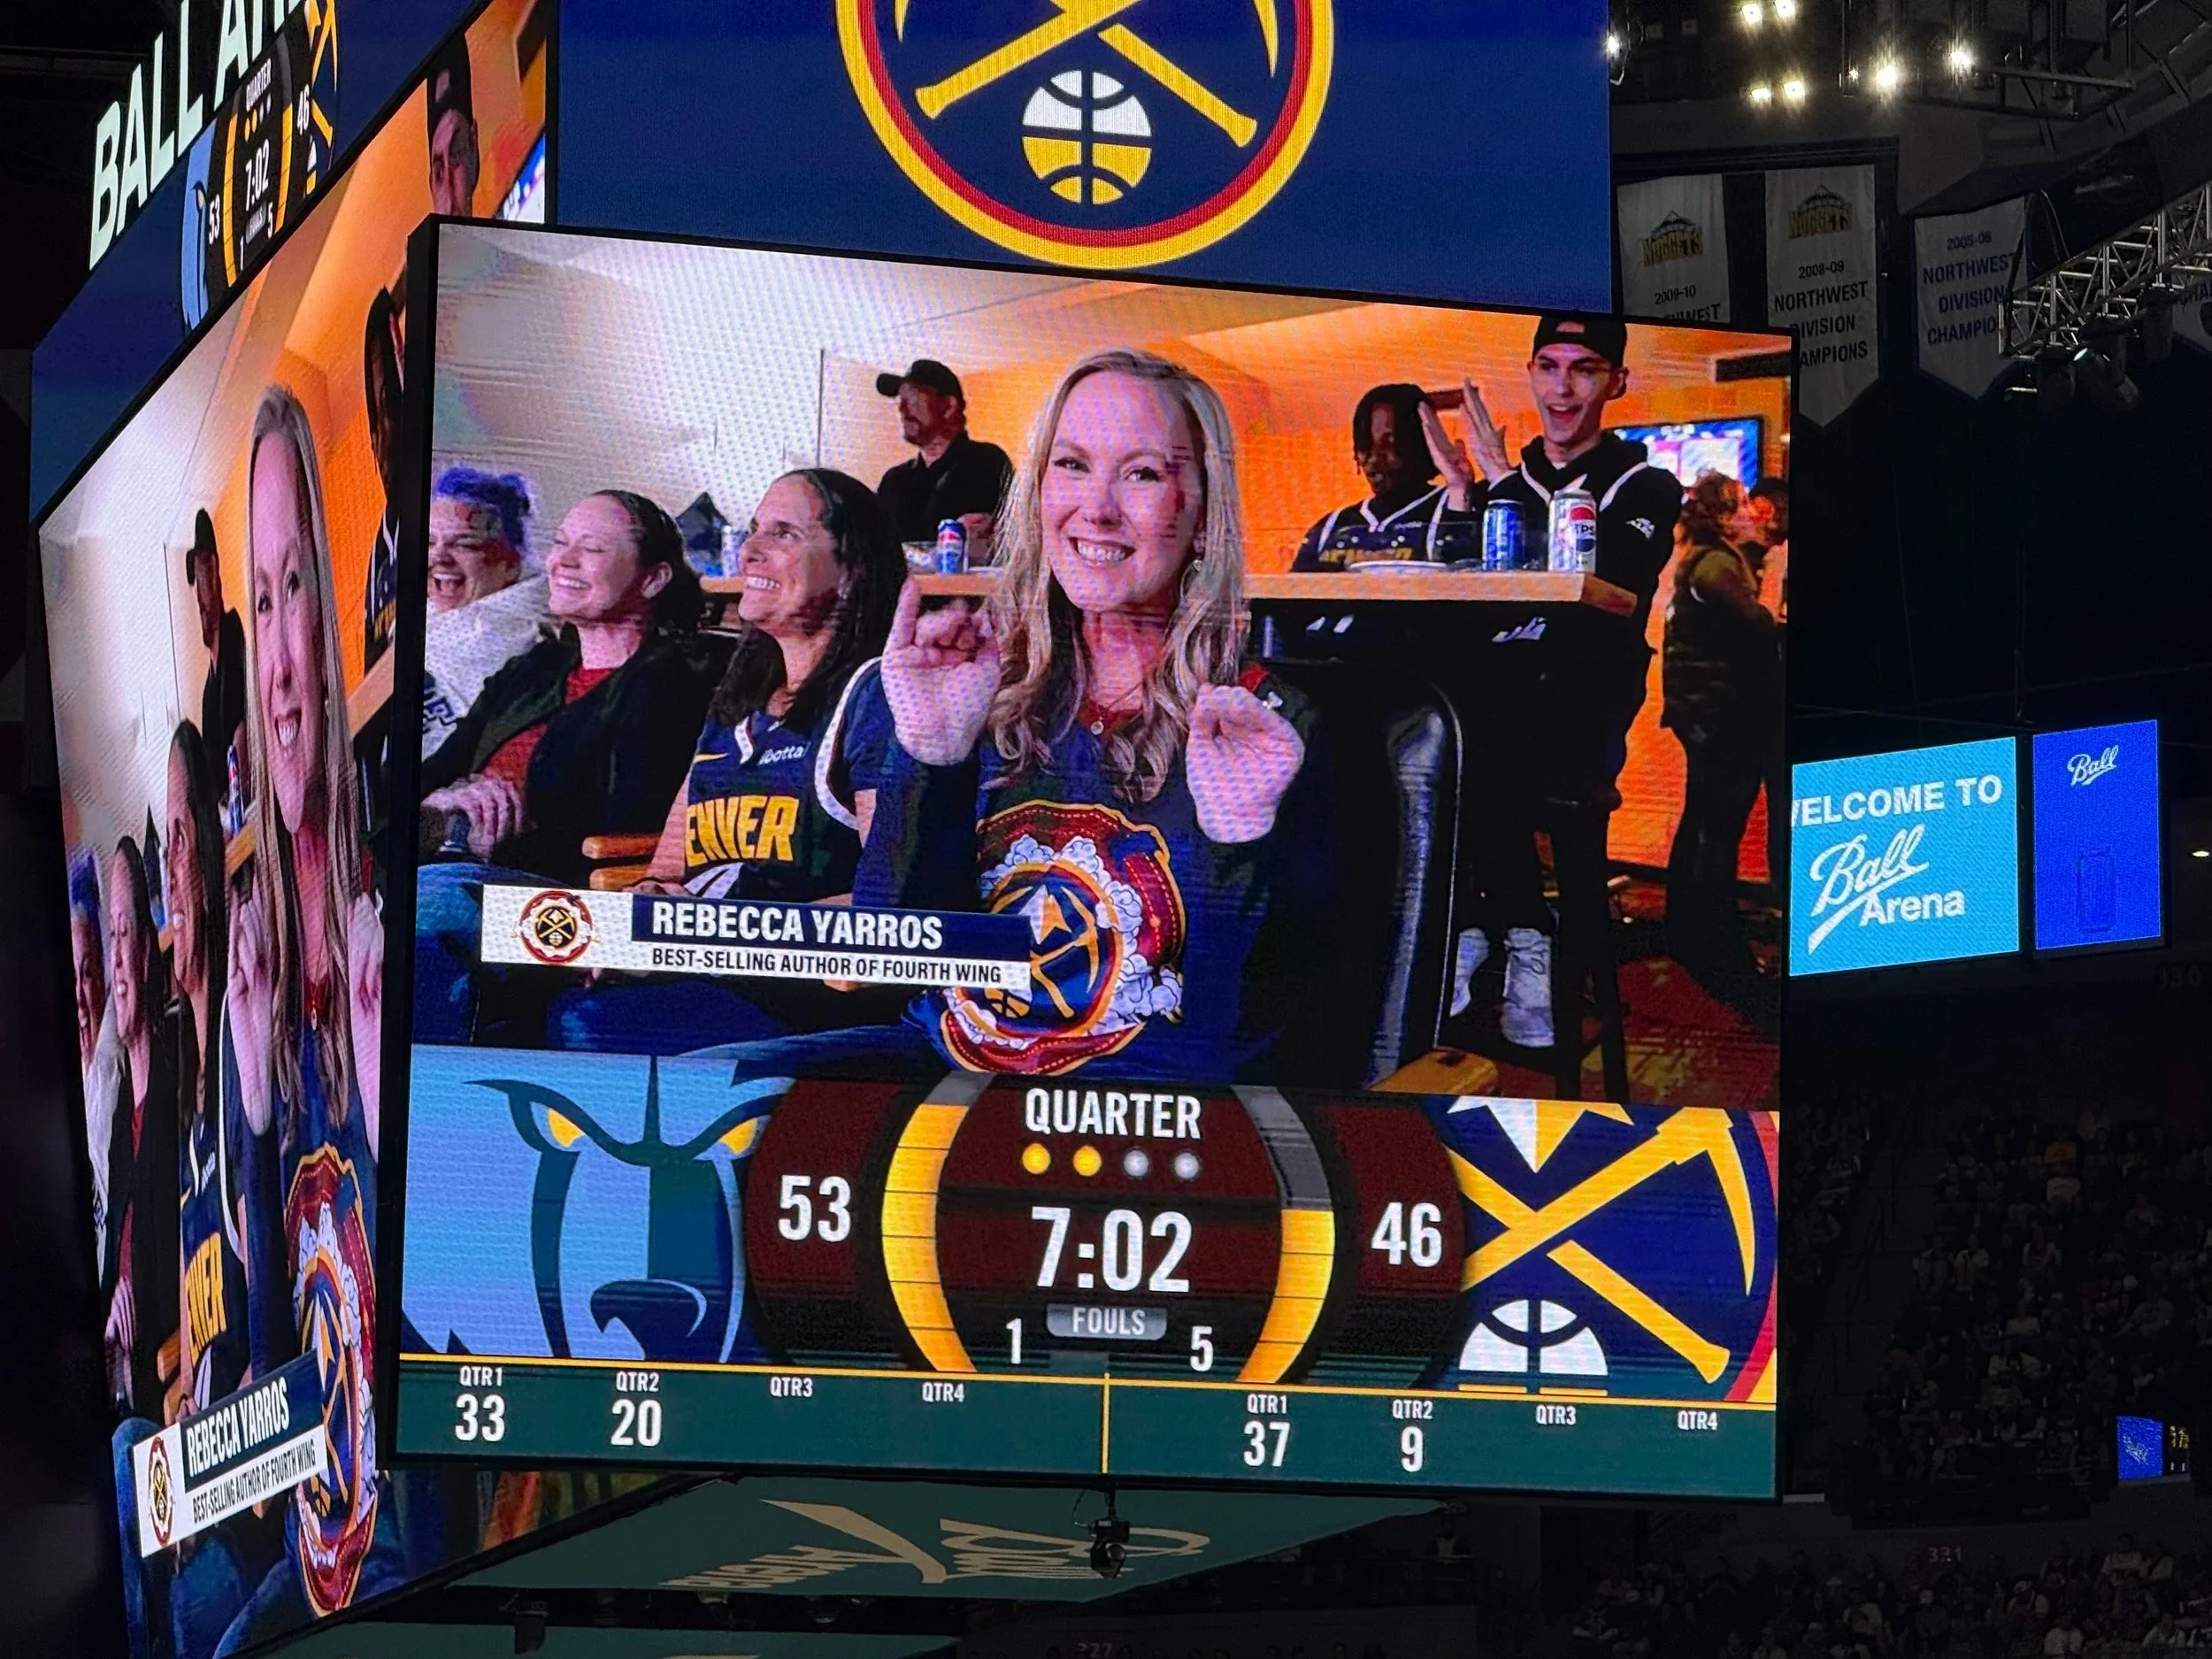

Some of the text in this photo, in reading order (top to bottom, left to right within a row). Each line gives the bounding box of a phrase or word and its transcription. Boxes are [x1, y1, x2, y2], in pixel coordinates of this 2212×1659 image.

[296, 84, 310, 135] 46
[89, 0, 204, 271] BALL
[245, 138, 270, 212] 7:02
[208, 194, 220, 245] 53
[267, 202, 273, 240] 5
[239, 235, 245, 272] 1
[1798, 260, 1845, 280] 2008-09
[1655, 285, 1696, 304] 2009-10
[1774, 280, 1869, 312] NORTHWEST
[1939, 284, 2005, 313] DIVISION
[1927, 315, 1997, 345] CHAMPIO
[1799, 341, 1869, 367] AMPIONS
[2067, 744, 2119, 787] Ball
[1955, 774, 2003, 807] TO
[686, 794, 800, 867] ENVER
[1808, 823, 1930, 955] Ball
[1860, 890, 1966, 927] Arena
[652, 901, 943, 951] REBECCA YARROS
[651, 948, 1002, 984] BEST-SELLING AUTHOR OF FOURTH WING
[1025, 1087, 1202, 1140] QUARTER
[779, 1175, 852, 1243] 53
[1031, 1206, 1192, 1293] 7:02
[1371, 1202, 1443, 1267] 46
[185, 1232, 227, 1368] ENVER
[1071, 1306, 1147, 1336] FOULS
[1005, 1317, 1023, 1365] 1
[1189, 1326, 1214, 1371] 5
[459, 1365, 503, 1388] QTR1
[615, 1371, 659, 1394] QTR2
[769, 1377, 813, 1398] QTR3
[921, 1382, 965, 1403] QTR4
[454, 1393, 506, 1443] 33
[611, 1398, 662, 1448] 20
[1247, 1394, 1287, 1416] QTR1
[1392, 1400, 1433, 1421] QTR2
[1535, 1405, 1577, 1426] QTR3
[1678, 1410, 1718, 1432] QTR4
[186, 1376, 290, 1479] REBECCA YARROS
[1242, 1420, 1291, 1469] 37
[1400, 1425, 1425, 1473] 9
[192, 1438, 317, 1525] BEST-SELLING AUTHOR OF FOURTH WING
